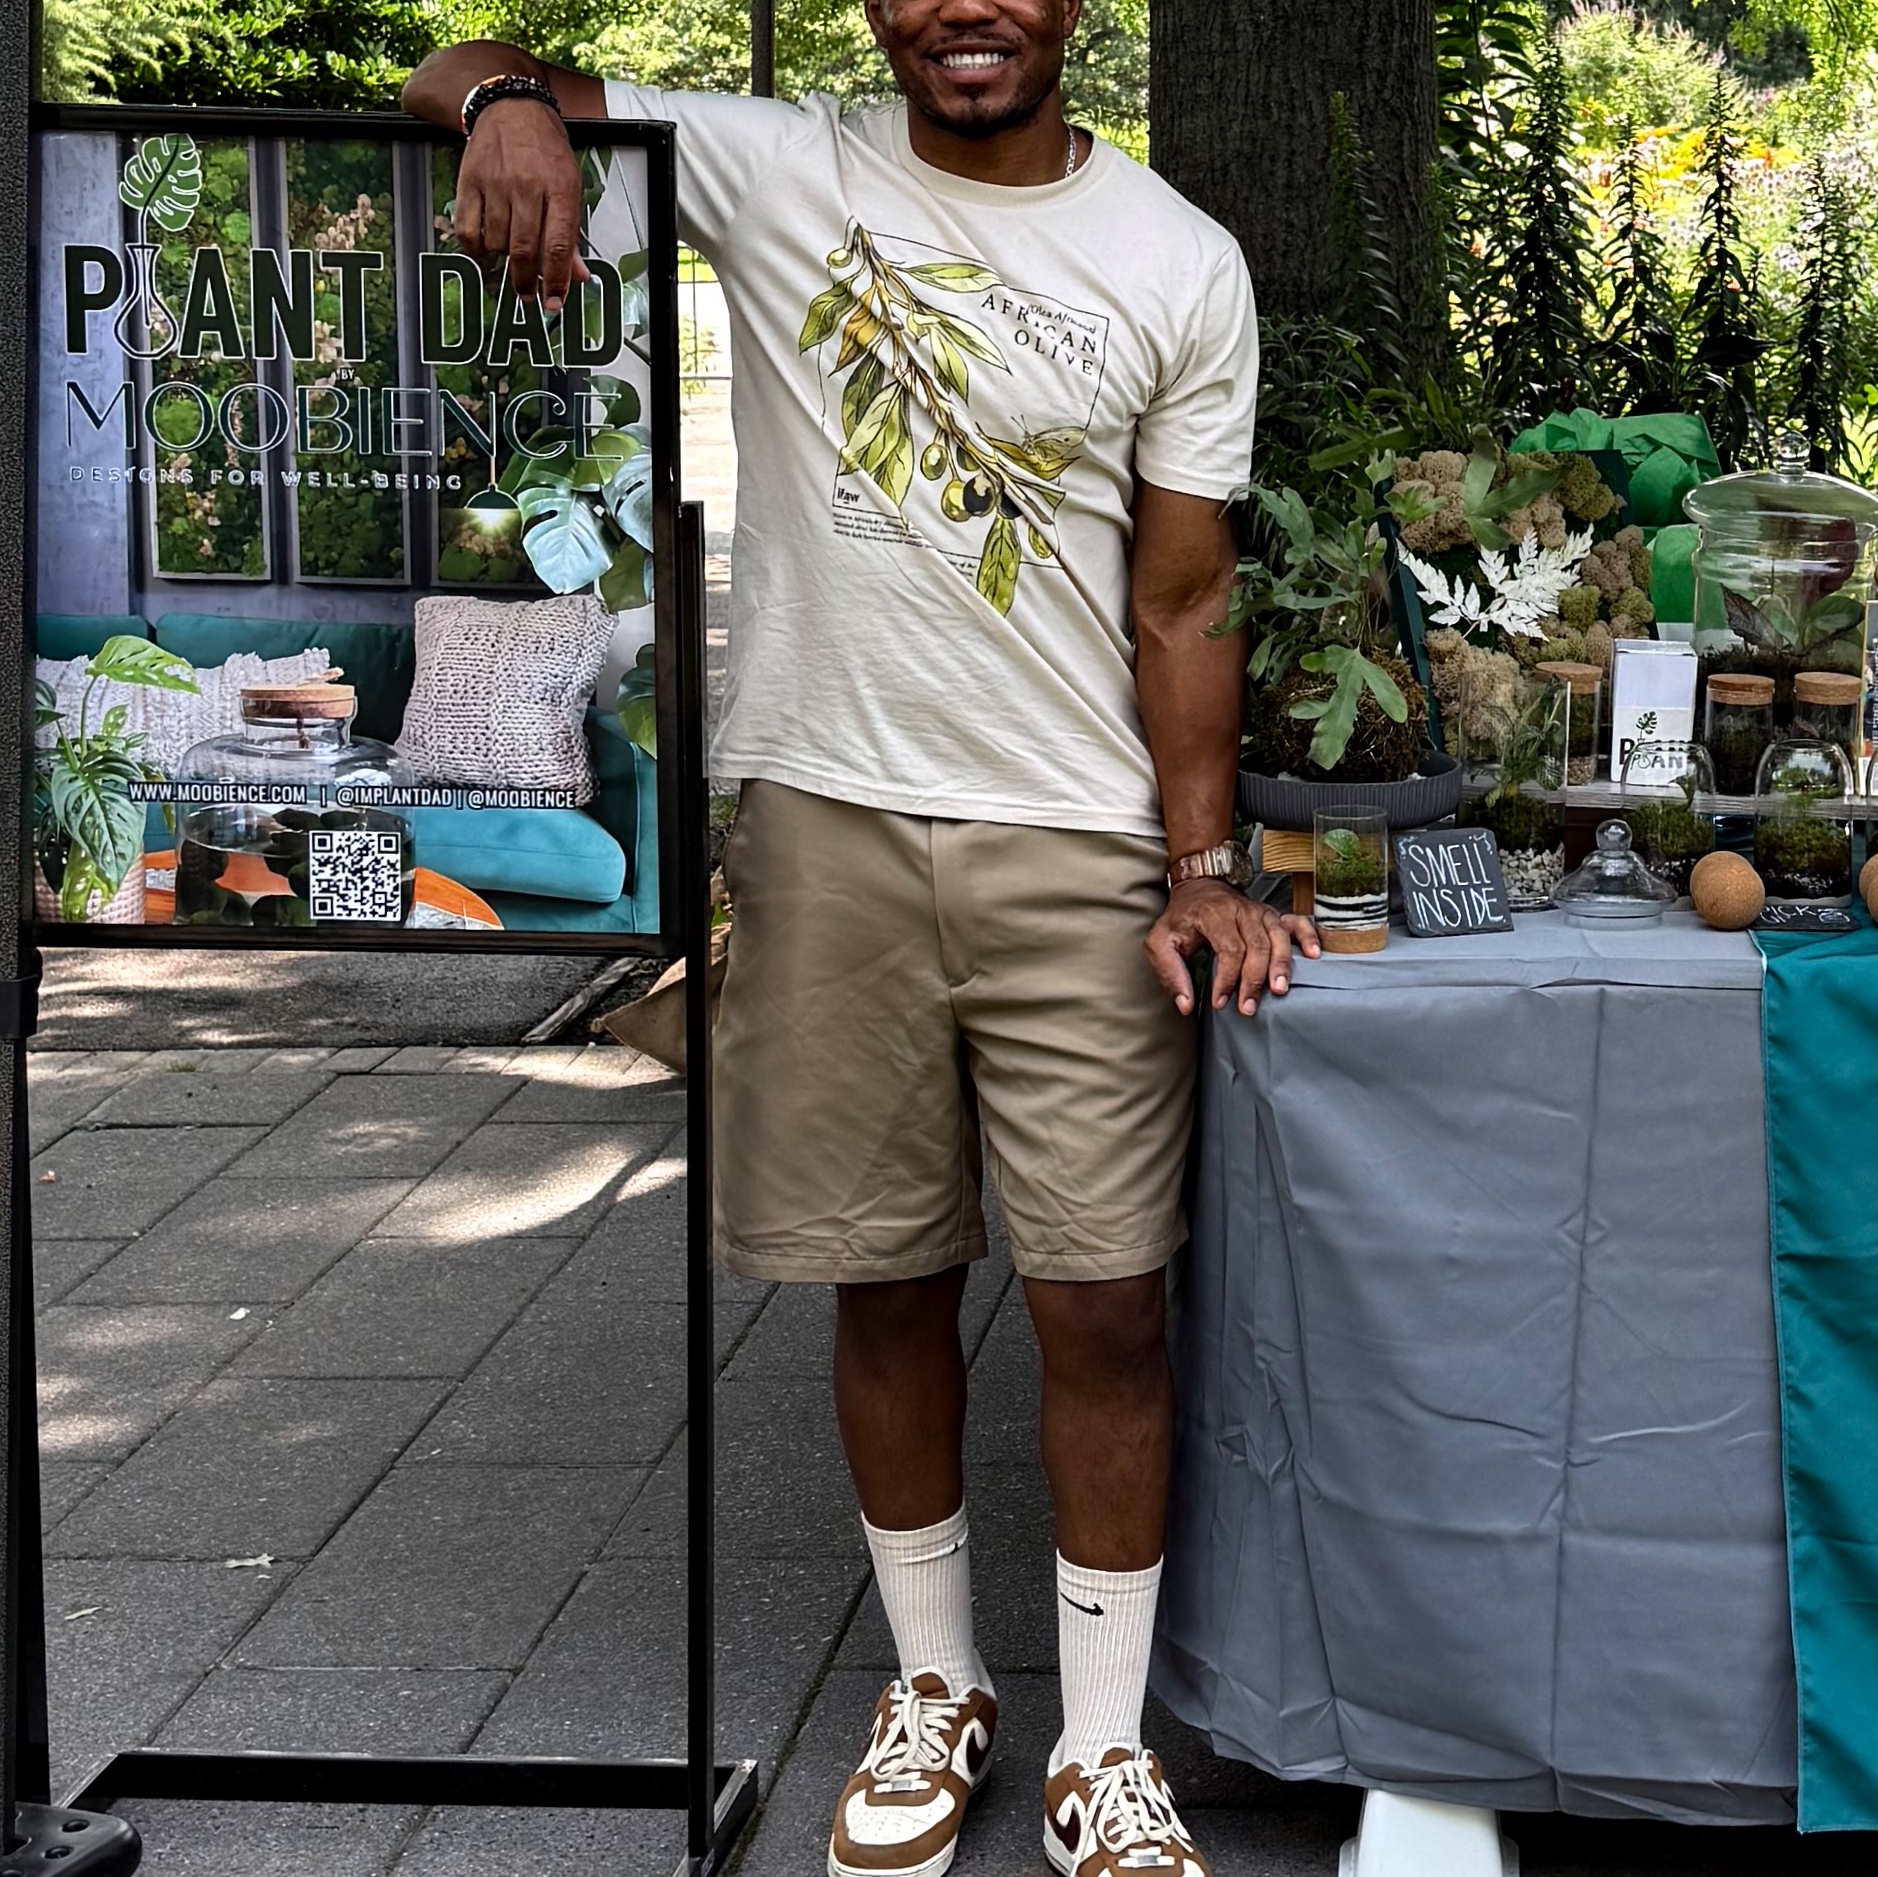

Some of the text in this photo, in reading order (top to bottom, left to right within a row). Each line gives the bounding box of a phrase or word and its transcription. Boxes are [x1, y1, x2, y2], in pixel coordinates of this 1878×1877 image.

[419, 252, 623, 367] DAD
[341, 368, 356, 381] BY
[1014, 329, 1093, 376] OLIVE
[66, 380, 623, 462] MOOBIENCE
[69, 466, 462, 491] DESIGNS FOR WELL-BEING
[128, 783, 576, 810] WWW.MOOBIENCE.COM @IMPLANTDAD @MOOBIENCE
[1408, 843, 1491, 887] SMELL
